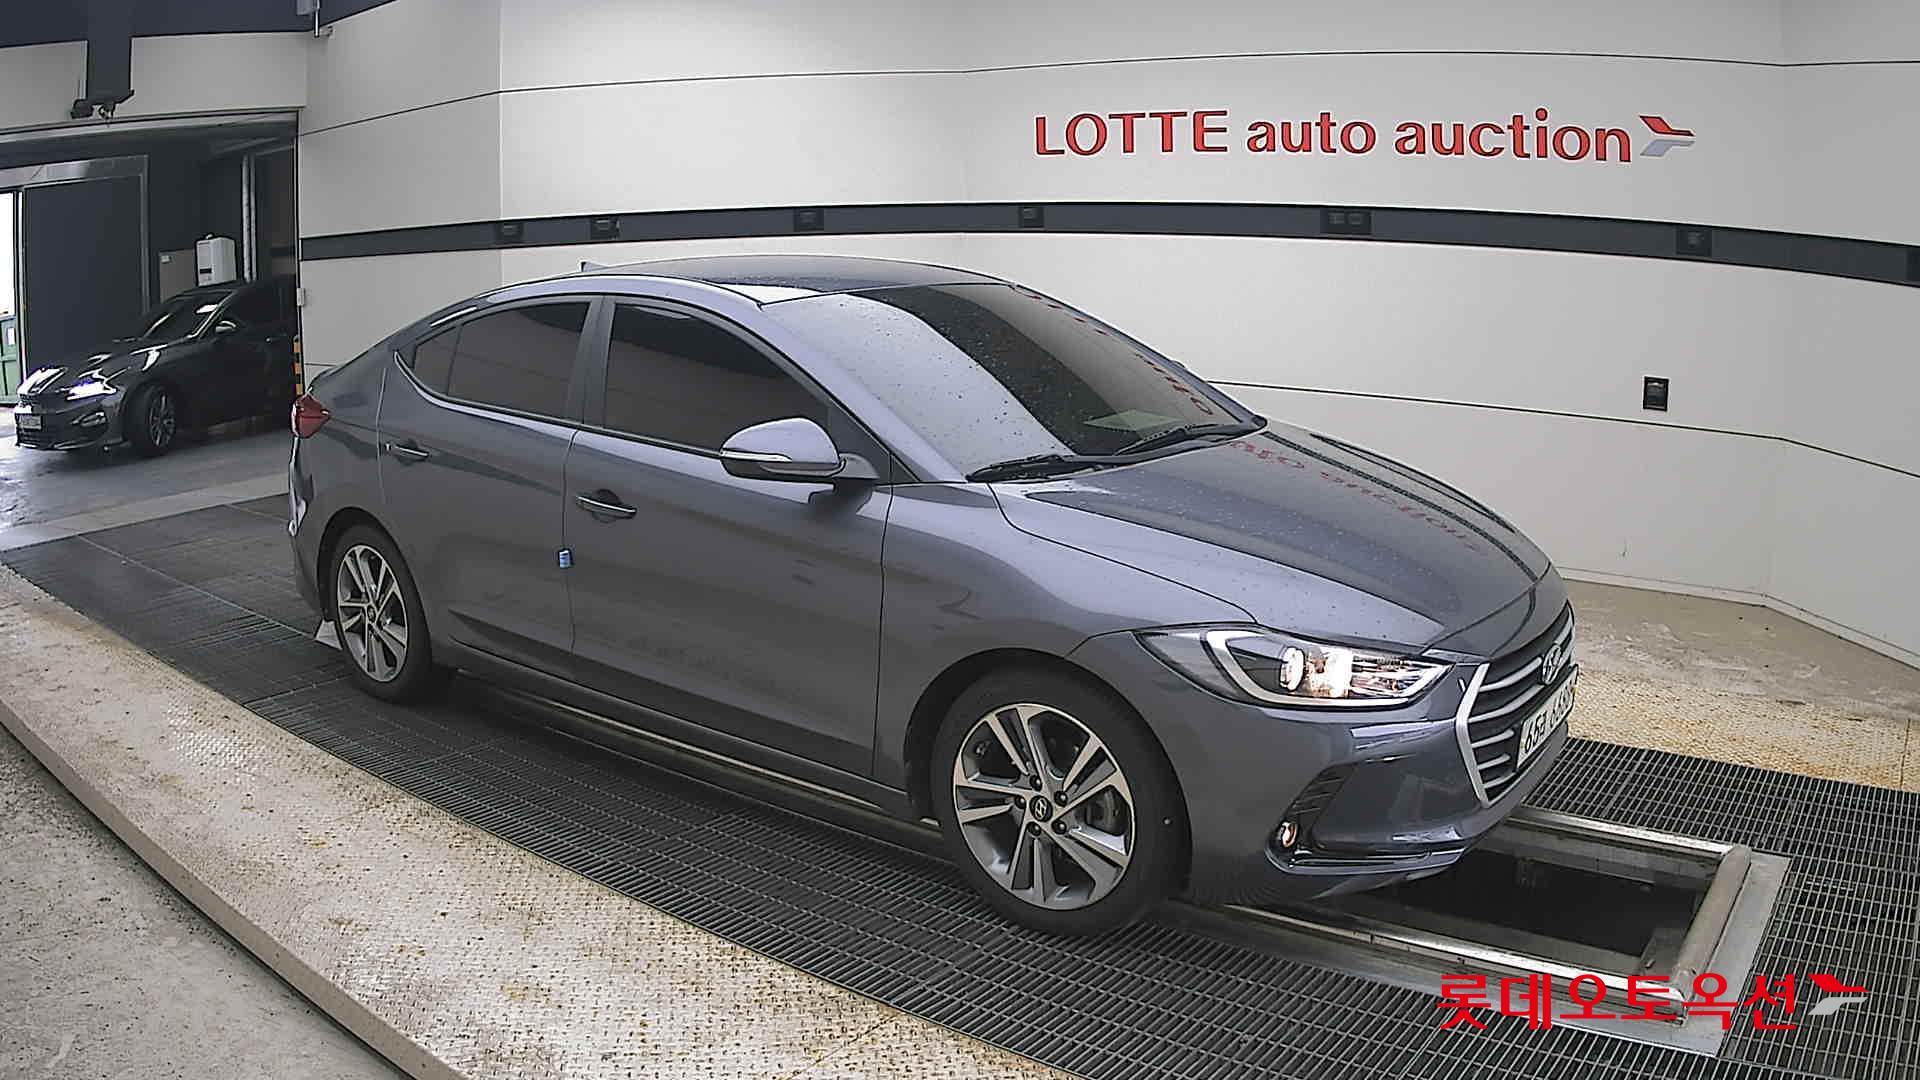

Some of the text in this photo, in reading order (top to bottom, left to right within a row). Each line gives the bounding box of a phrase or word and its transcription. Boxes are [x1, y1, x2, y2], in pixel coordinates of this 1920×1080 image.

[1035, 108, 1632, 162] LOTTE auto auction
